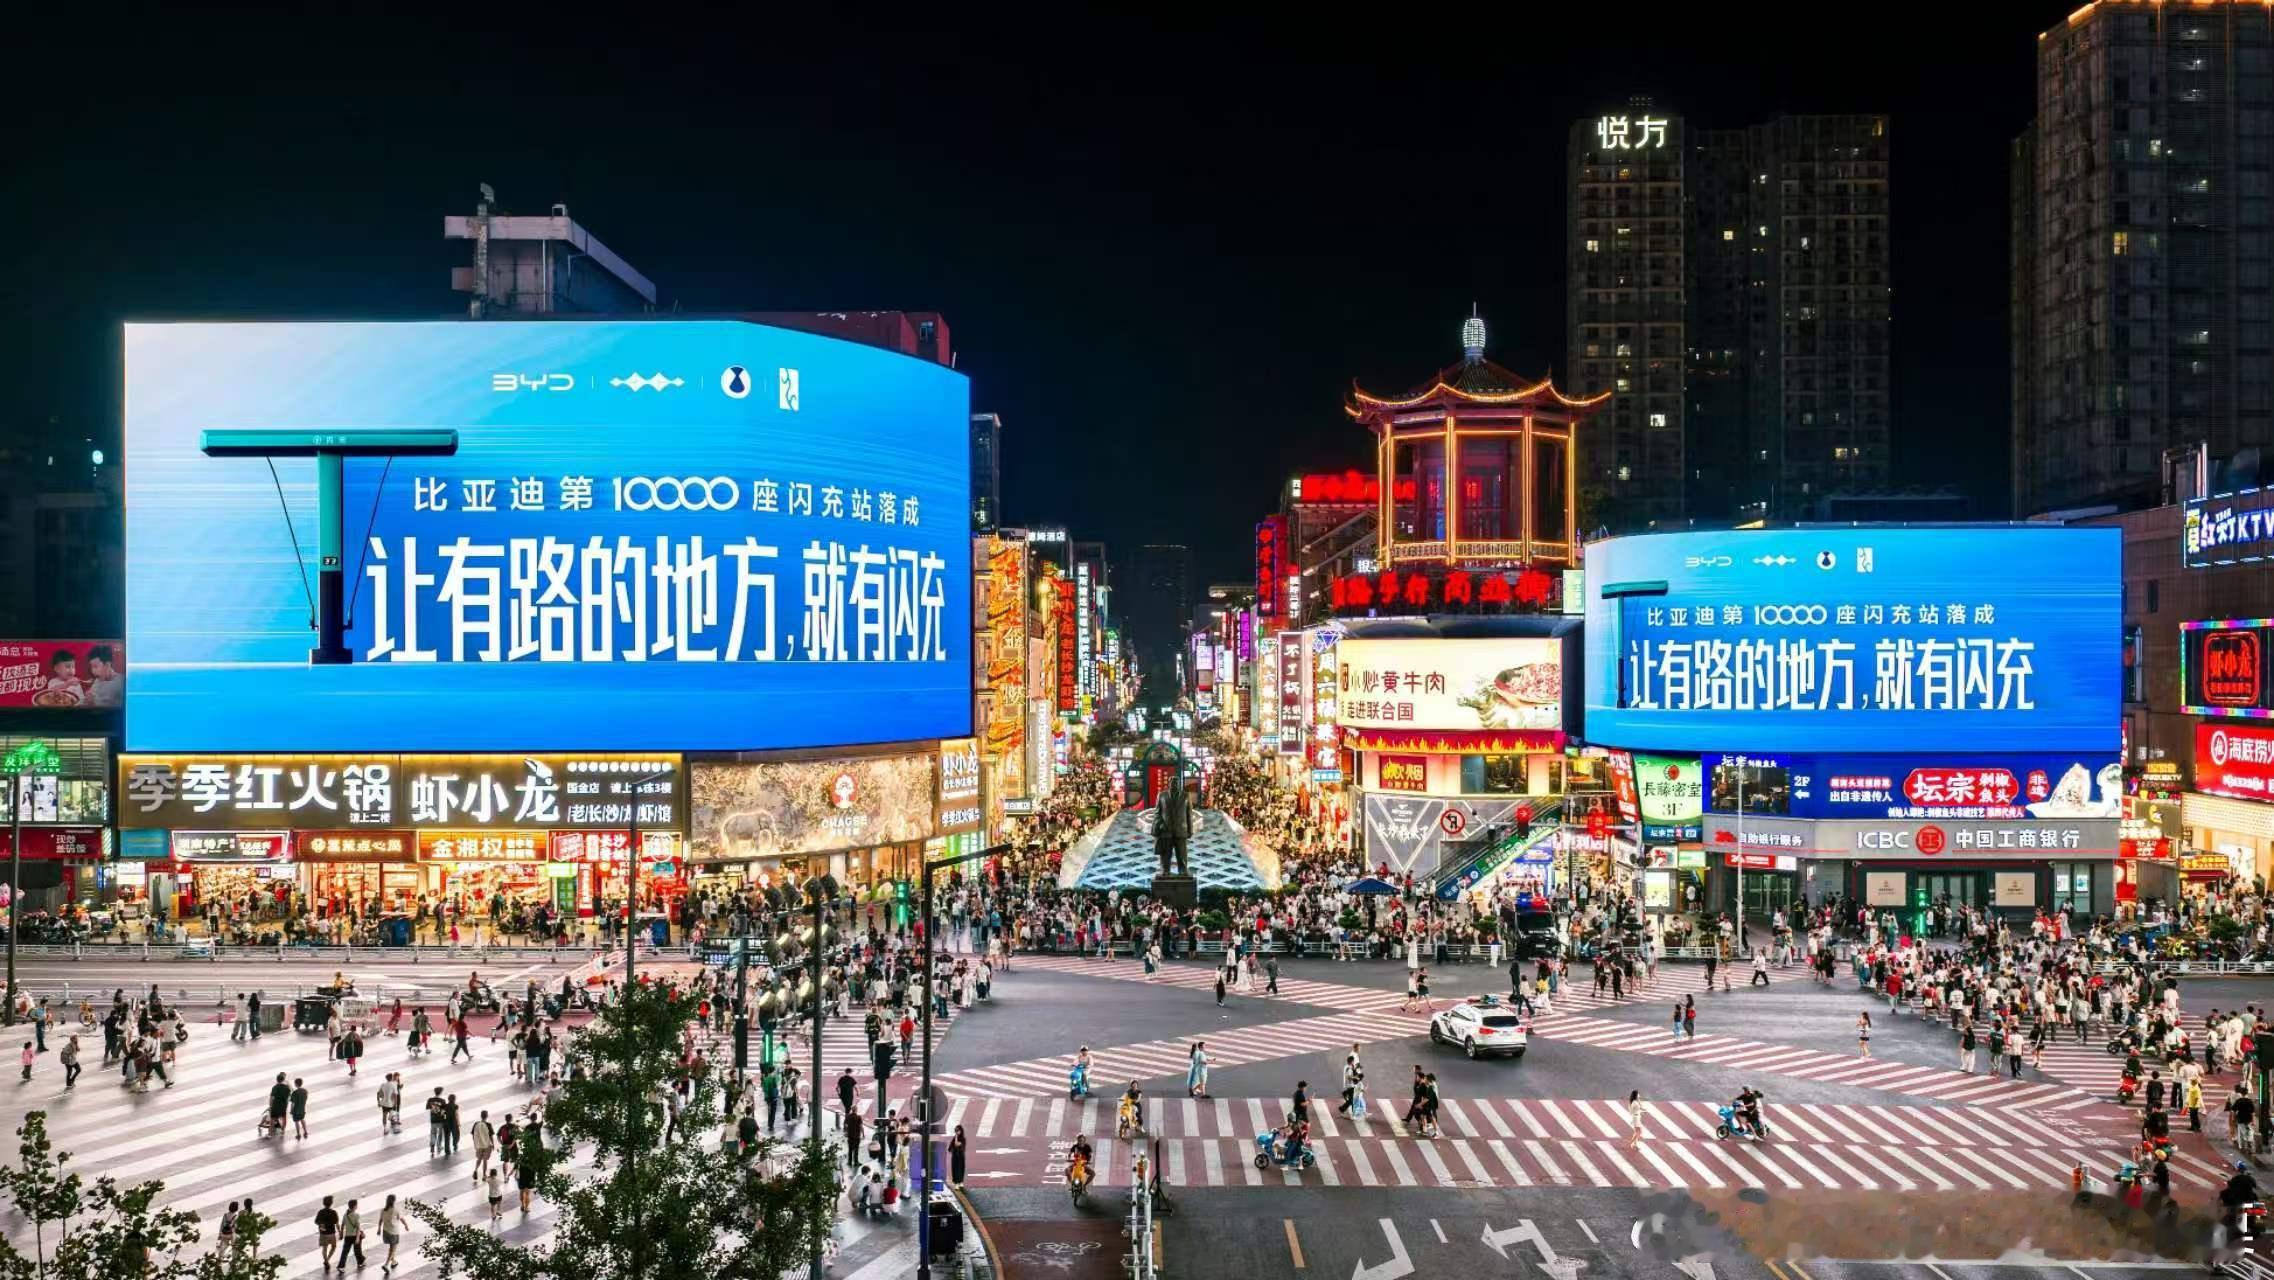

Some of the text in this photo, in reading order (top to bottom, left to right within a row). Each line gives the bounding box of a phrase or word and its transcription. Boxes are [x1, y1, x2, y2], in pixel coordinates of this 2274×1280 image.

[1598, 115, 1668, 149] 悦方
[492, 374, 574, 391] BYD
[413, 475, 921, 527] 比亚迪第 10000 座闪充站落成
[1685, 556, 1733, 567] BYD
[1647, 603, 1996, 627] 比亚迪第 10000 座闪充站落成
[1350, 670, 1446, 695] 小炒黄牛肉
[128, 762, 392, 813] 季季红火锅
[411, 766, 561, 824] 虾小龙
[567, 782, 600, 794] 国金店
[1829, 790, 1893, 803] 出自非遗传人
[1913, 773, 1976, 803] 坛宗
[349, 812, 392, 824] 请上二楼
[821, 815, 868, 829] CHAGEE
[1739, 832, 1803, 846] 自助银行服务
[1857, 831, 1909, 849] ICBC
[1955, 828, 2081, 849] 中国工商银行
